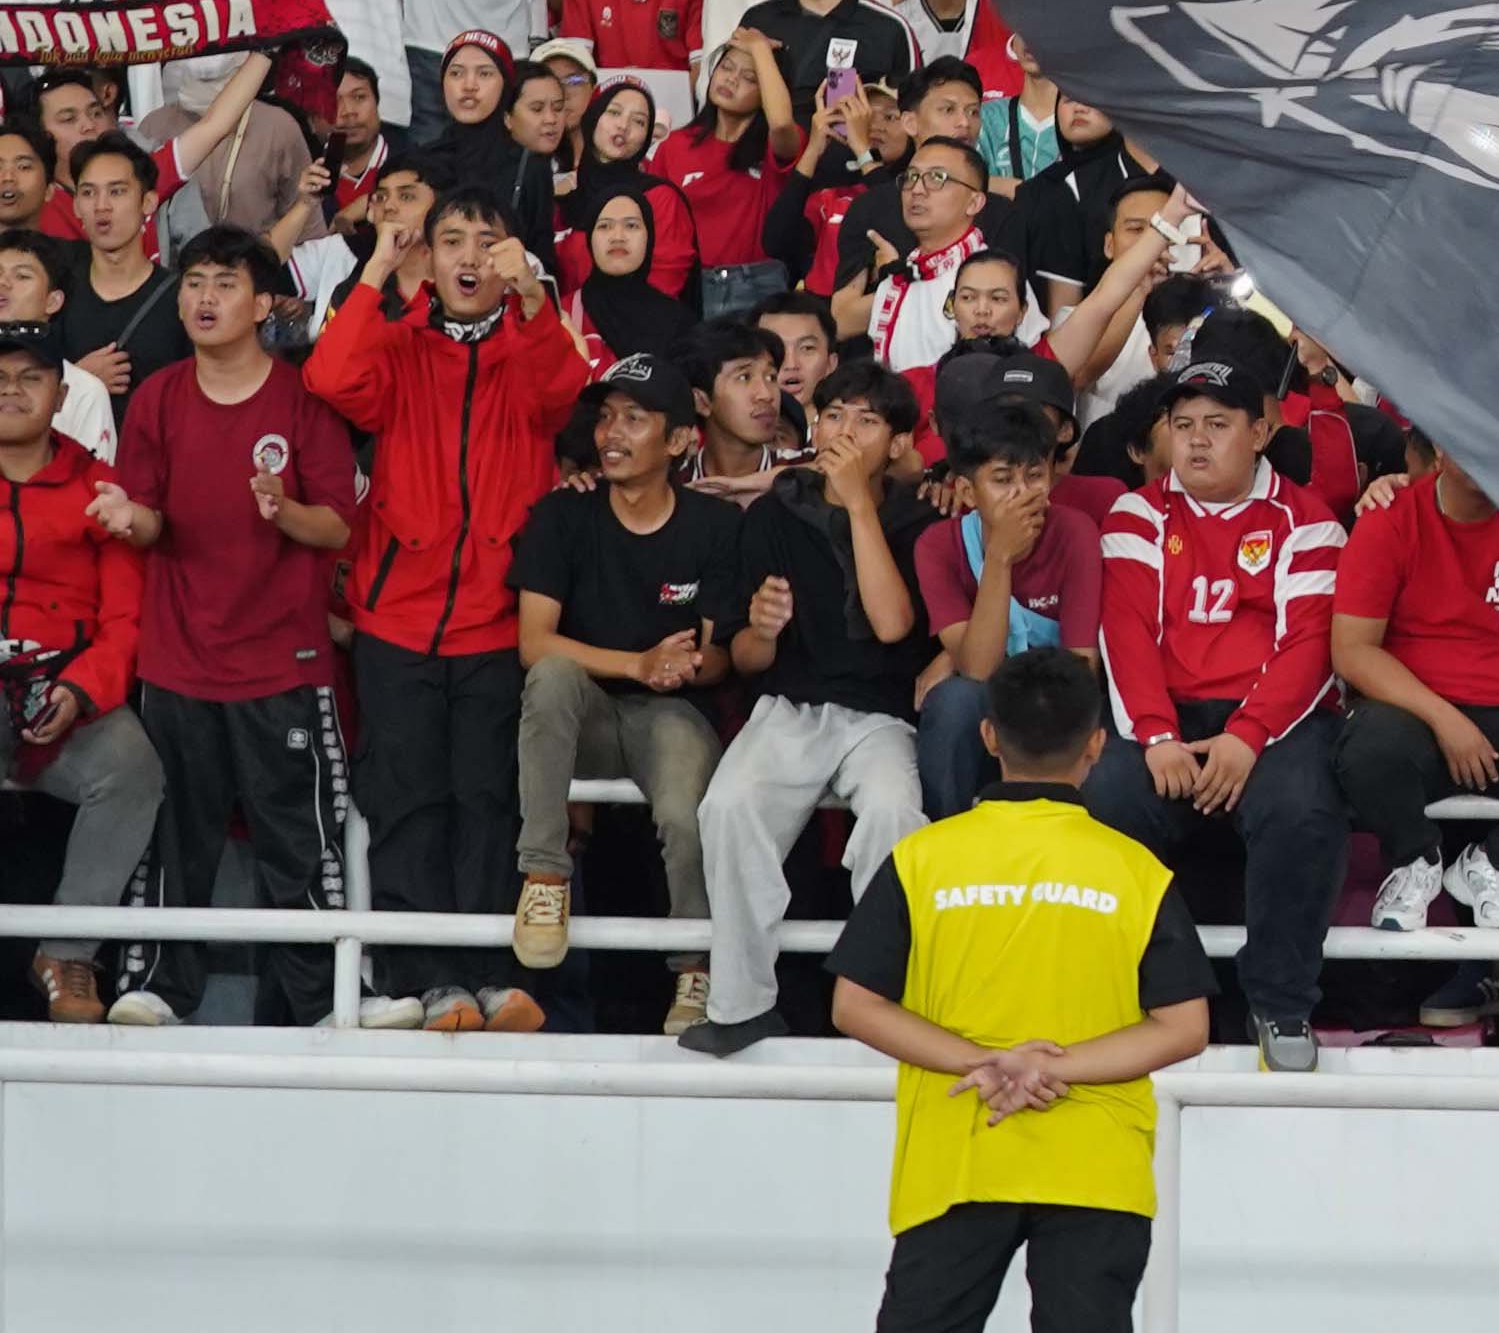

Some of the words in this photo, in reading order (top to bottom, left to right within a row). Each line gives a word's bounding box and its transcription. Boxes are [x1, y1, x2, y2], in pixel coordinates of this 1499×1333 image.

[1188, 575, 1235, 624] 12
[934, 884, 1028, 911] SAFETY
[1031, 882, 1119, 914] GUARD
